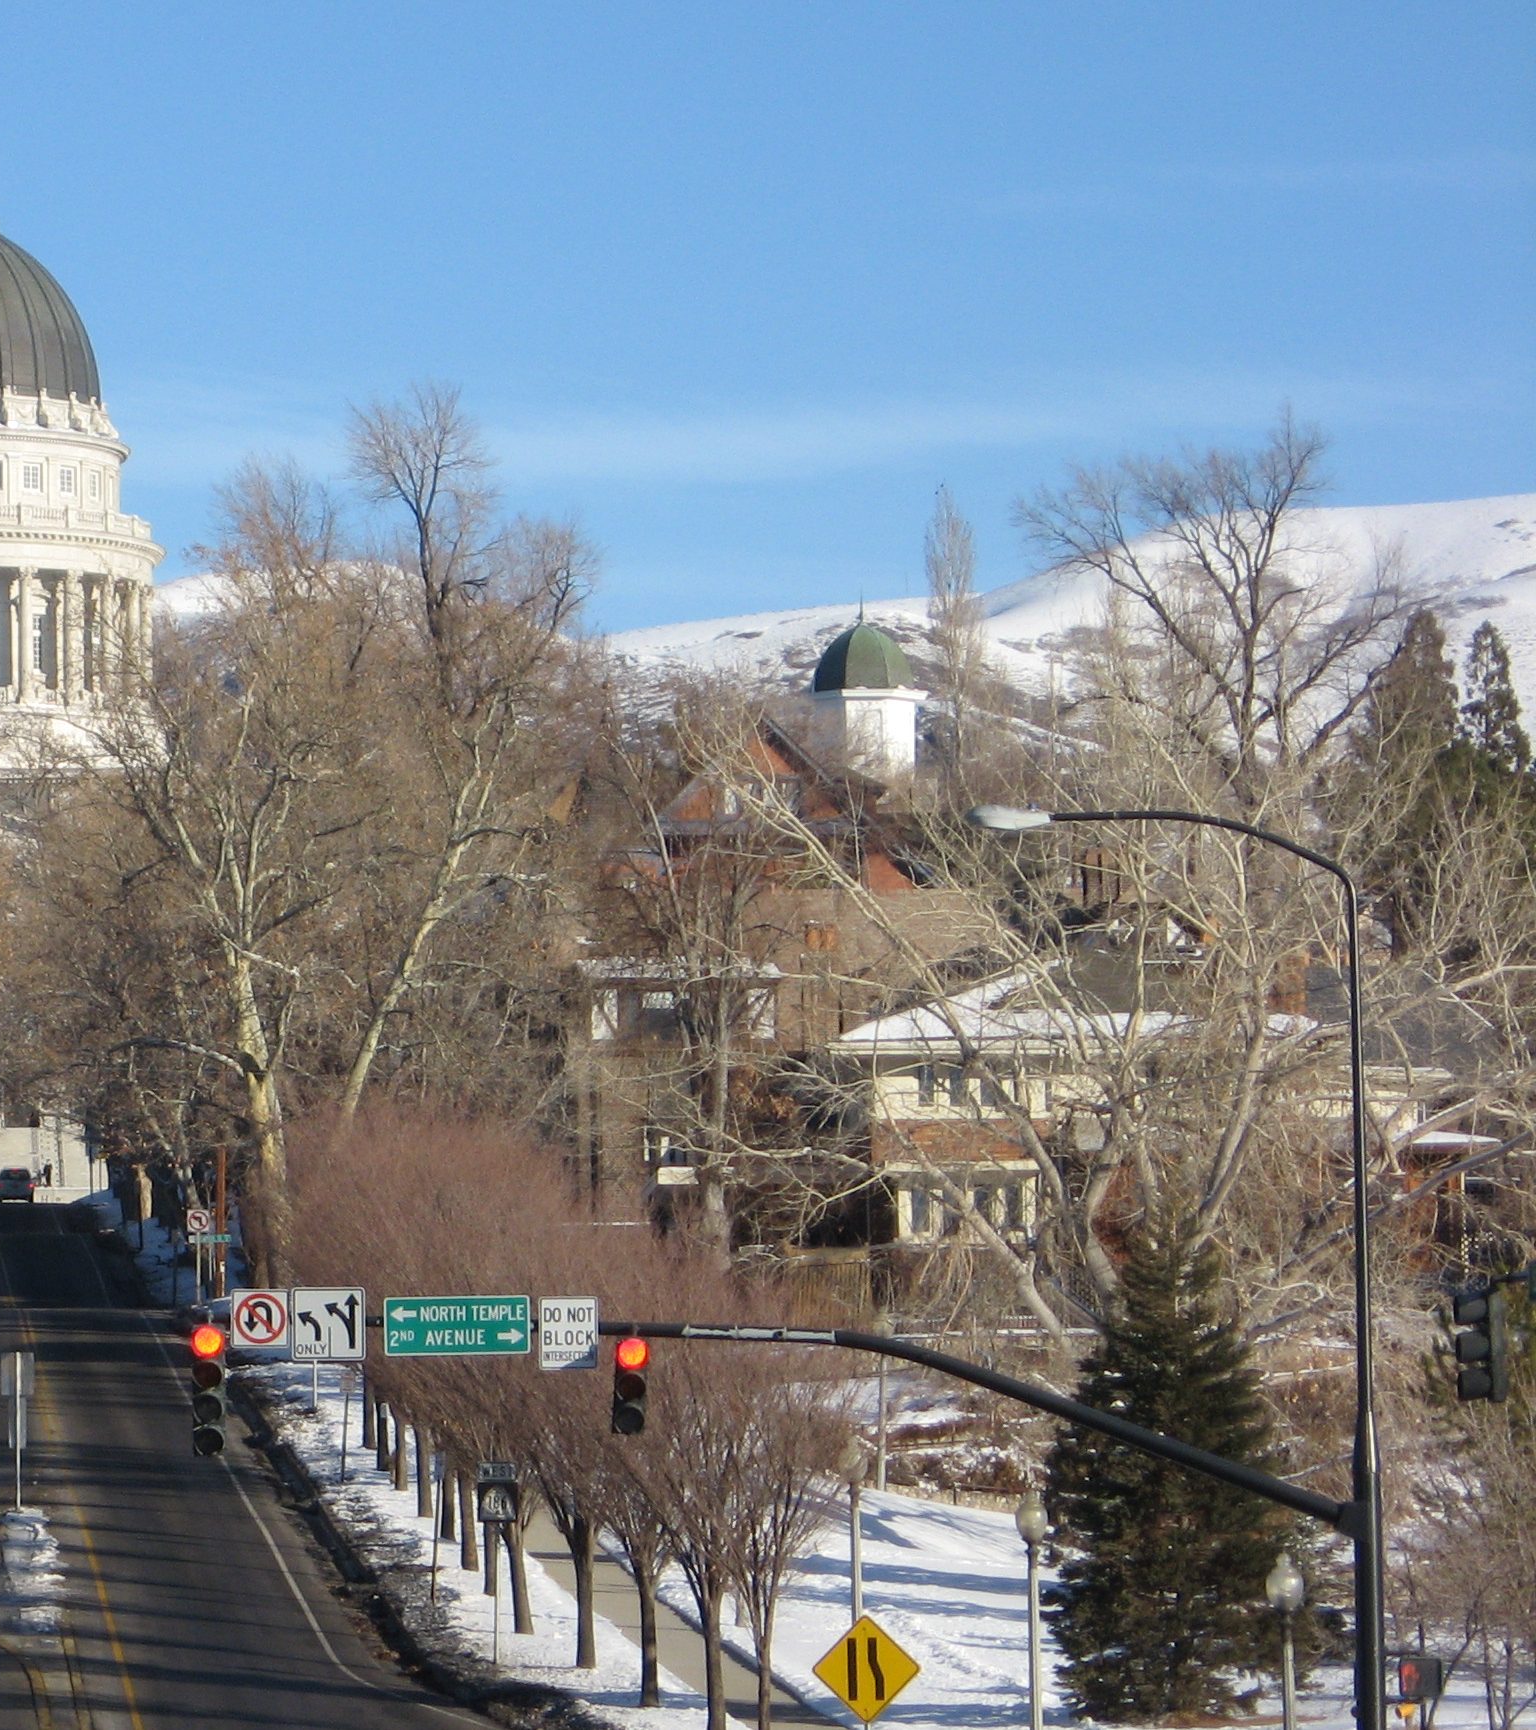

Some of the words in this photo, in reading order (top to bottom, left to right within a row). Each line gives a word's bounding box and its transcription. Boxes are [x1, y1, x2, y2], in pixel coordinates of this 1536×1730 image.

[420, 1305, 466, 1322] NORTH
[472, 1304, 525, 1321] TEMPLE
[544, 1307, 561, 1323] DO
[567, 1307, 594, 1323] NOT
[390, 1330, 414, 1347] 2ND
[425, 1329, 485, 1346] AVENUE
[544, 1330, 594, 1346] BLOCK
[296, 1344, 327, 1355] ONLY
[481, 1465, 513, 1477] WEST
